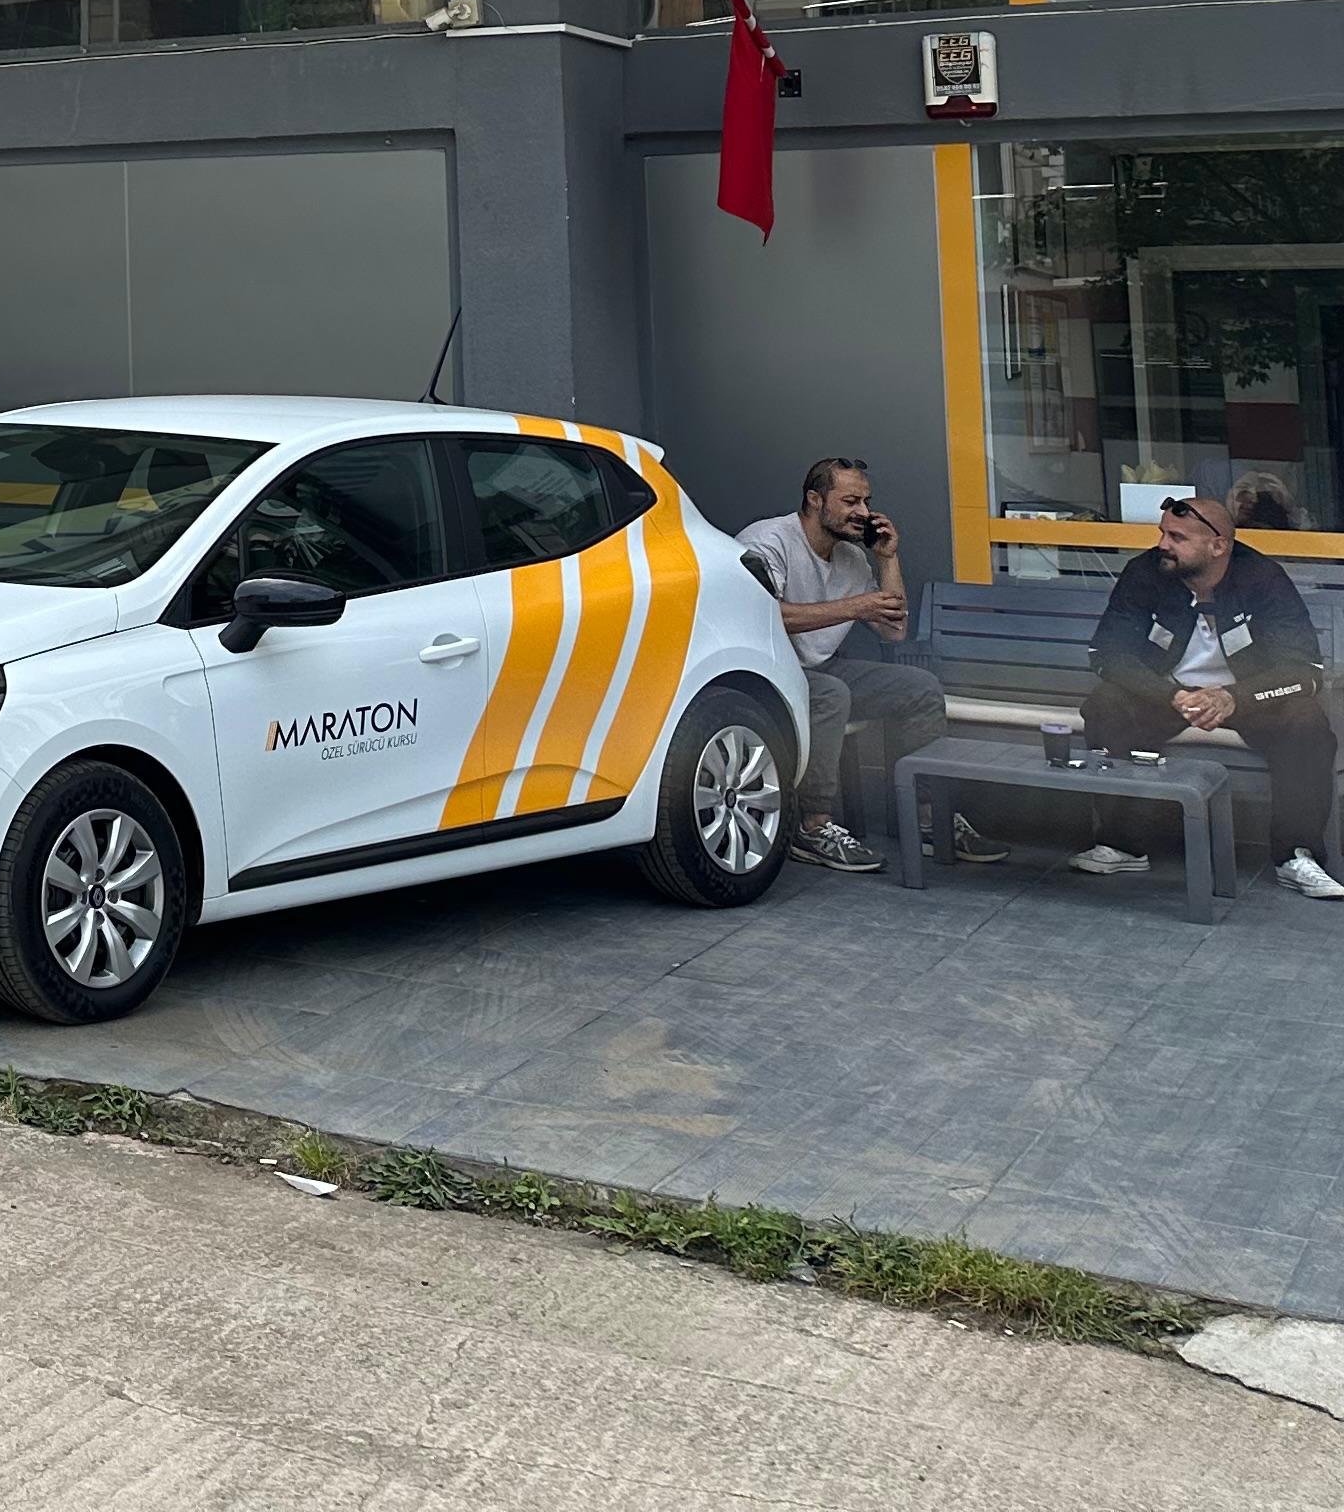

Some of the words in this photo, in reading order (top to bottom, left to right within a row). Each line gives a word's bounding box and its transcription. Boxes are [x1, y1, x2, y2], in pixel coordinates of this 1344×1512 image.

[272, 698, 418, 751] MARATON
[321, 744, 345, 761] ÖZEL
[387, 732, 418, 749] KURSU
